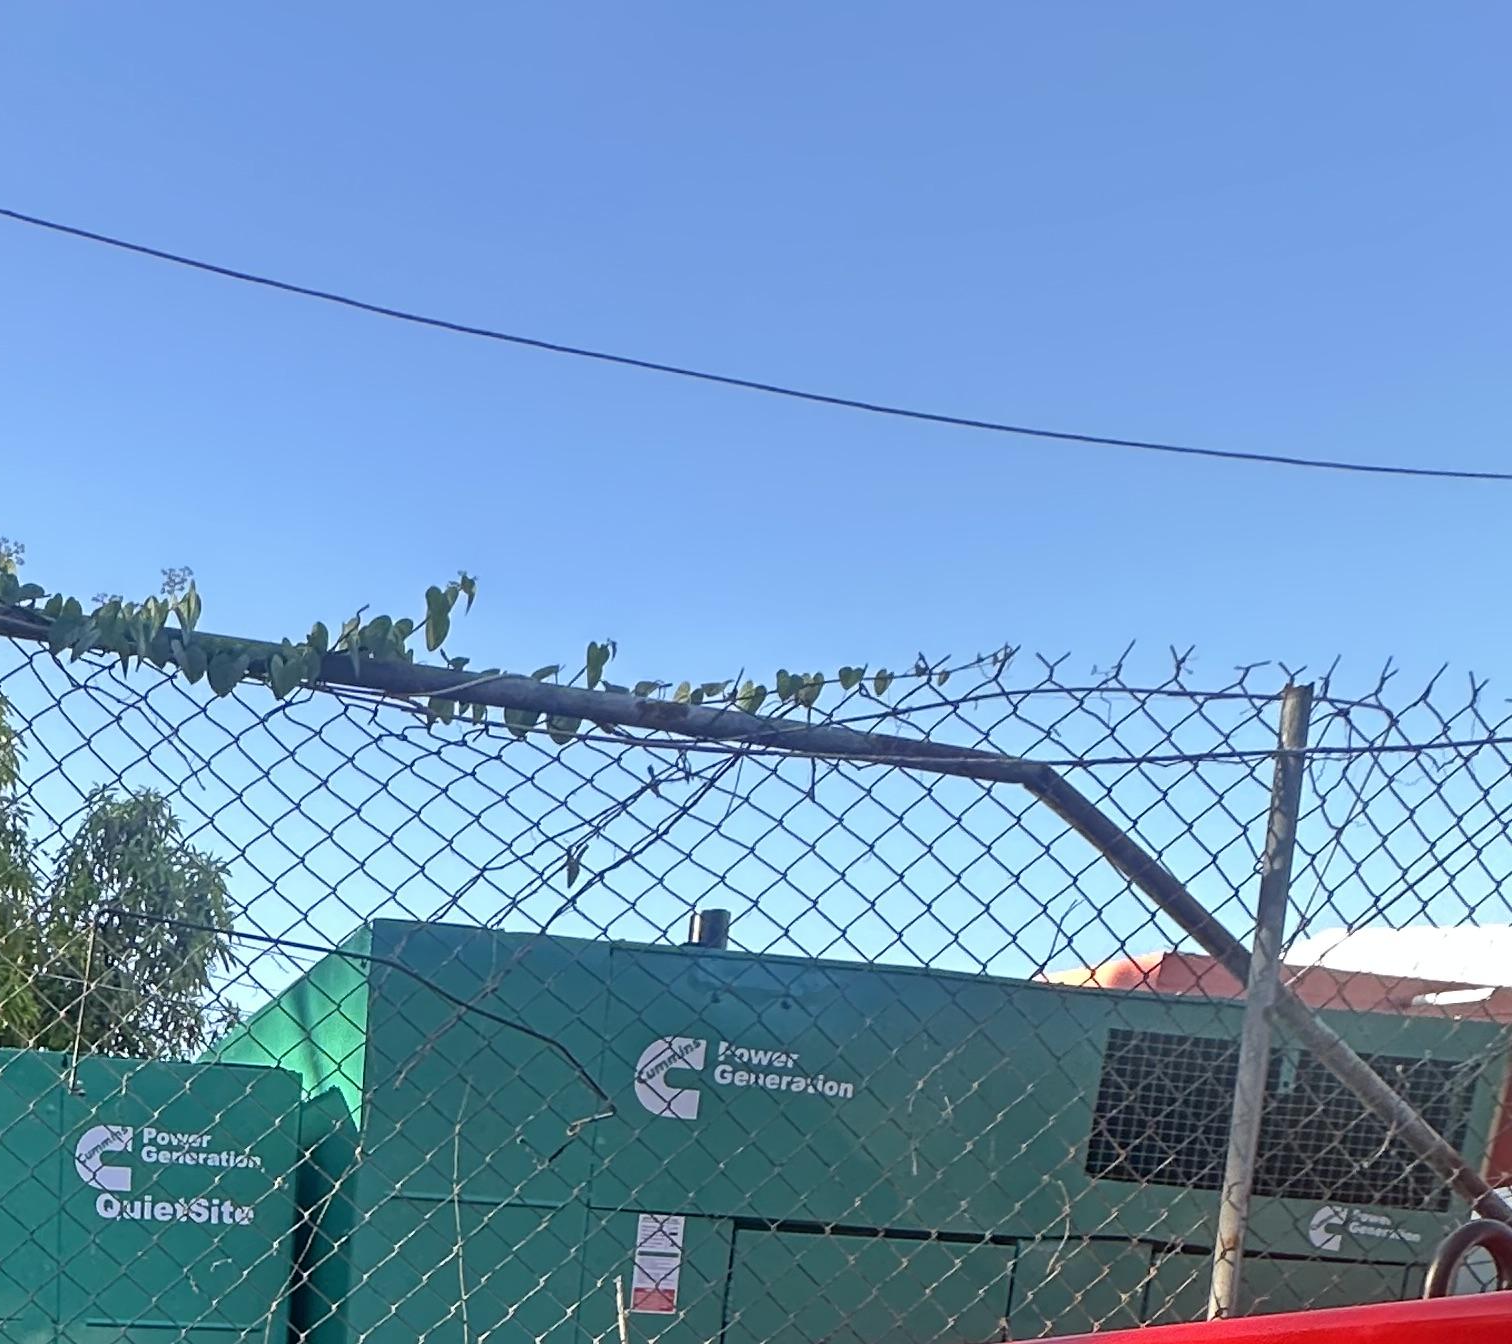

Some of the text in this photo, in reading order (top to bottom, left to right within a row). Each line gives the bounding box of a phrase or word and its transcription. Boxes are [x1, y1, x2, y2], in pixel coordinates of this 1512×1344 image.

[718, 1041, 800, 1069] Power
[714, 1064, 855, 1099] Generation
[143, 1127, 211, 1148] Power
[141, 1146, 262, 1169] Generation
[95, 1193, 255, 1226] QuietSite
